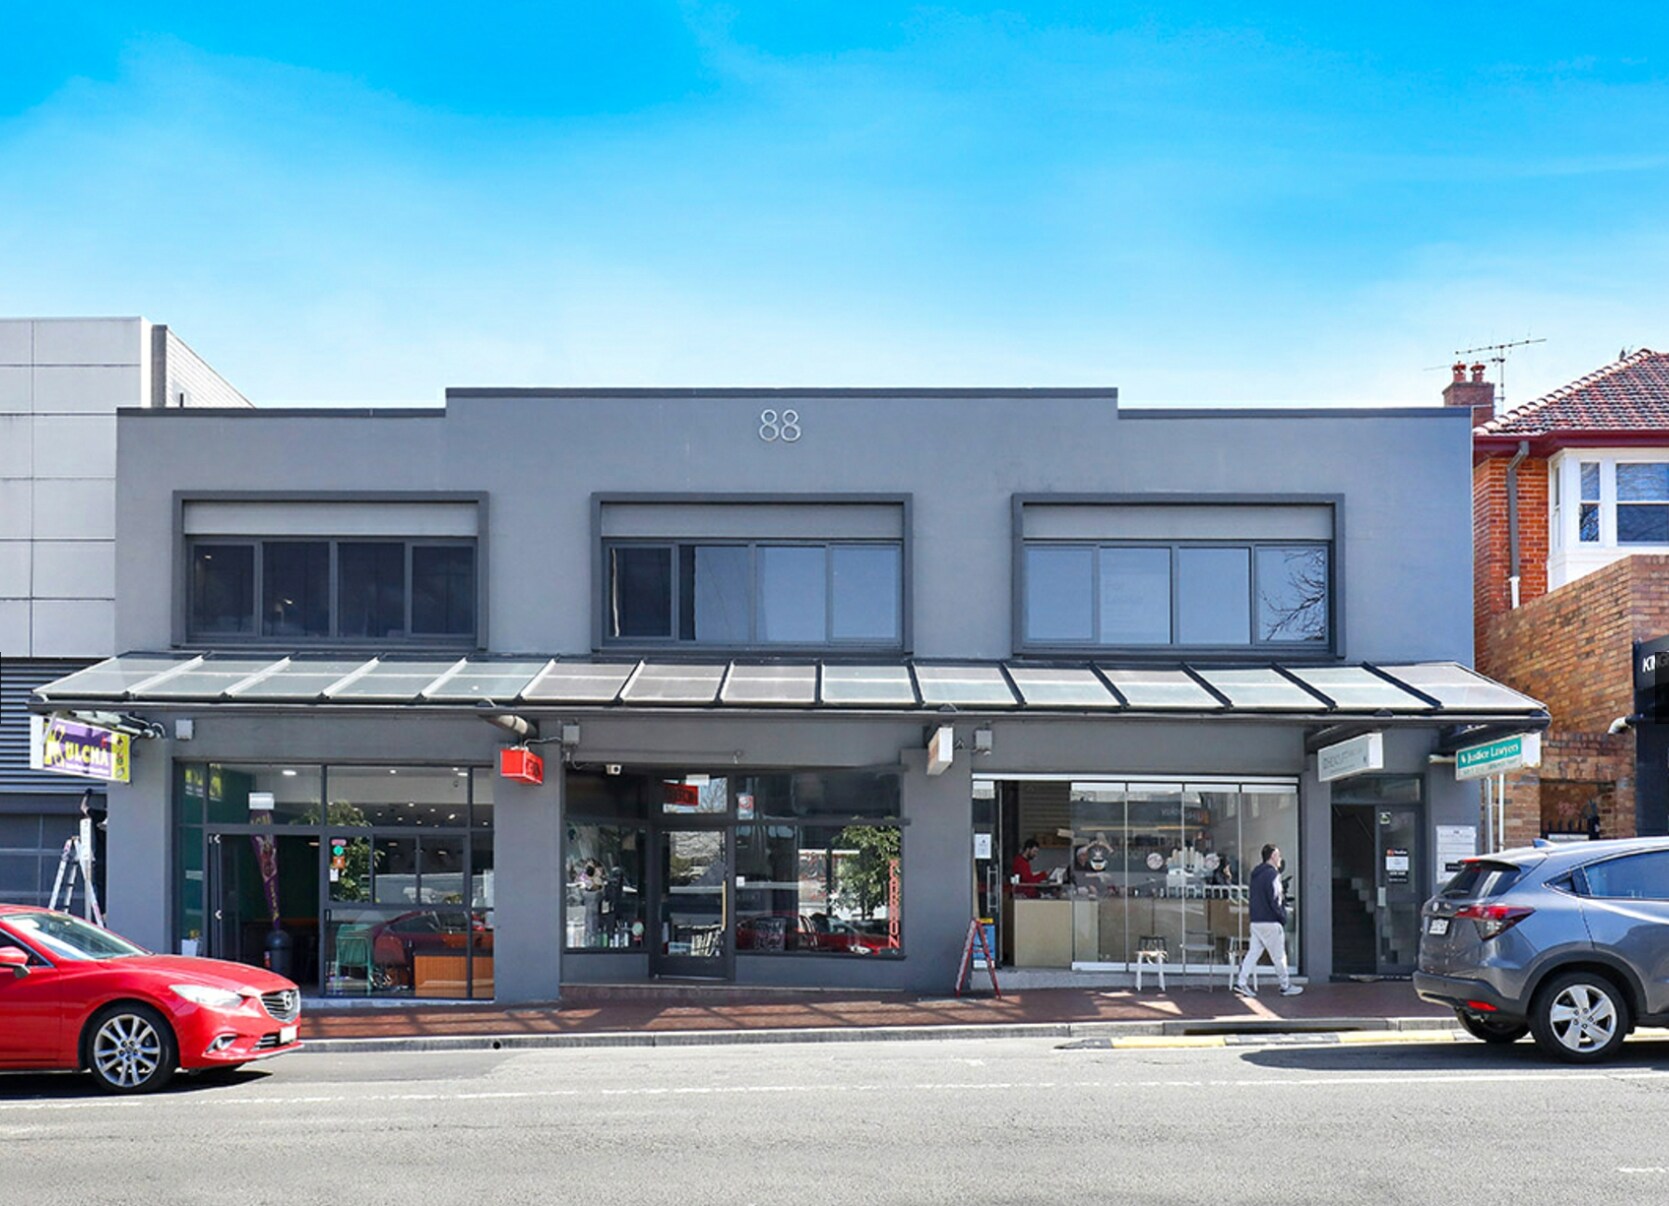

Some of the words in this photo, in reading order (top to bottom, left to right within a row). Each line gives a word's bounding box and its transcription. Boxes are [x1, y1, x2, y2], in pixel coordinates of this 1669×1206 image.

[759, 409, 801, 442] 88
[44, 724, 109, 767] KULCHA
[1467, 748, 1490, 764] Justice
[1490, 743, 1519, 758] Lawyers
